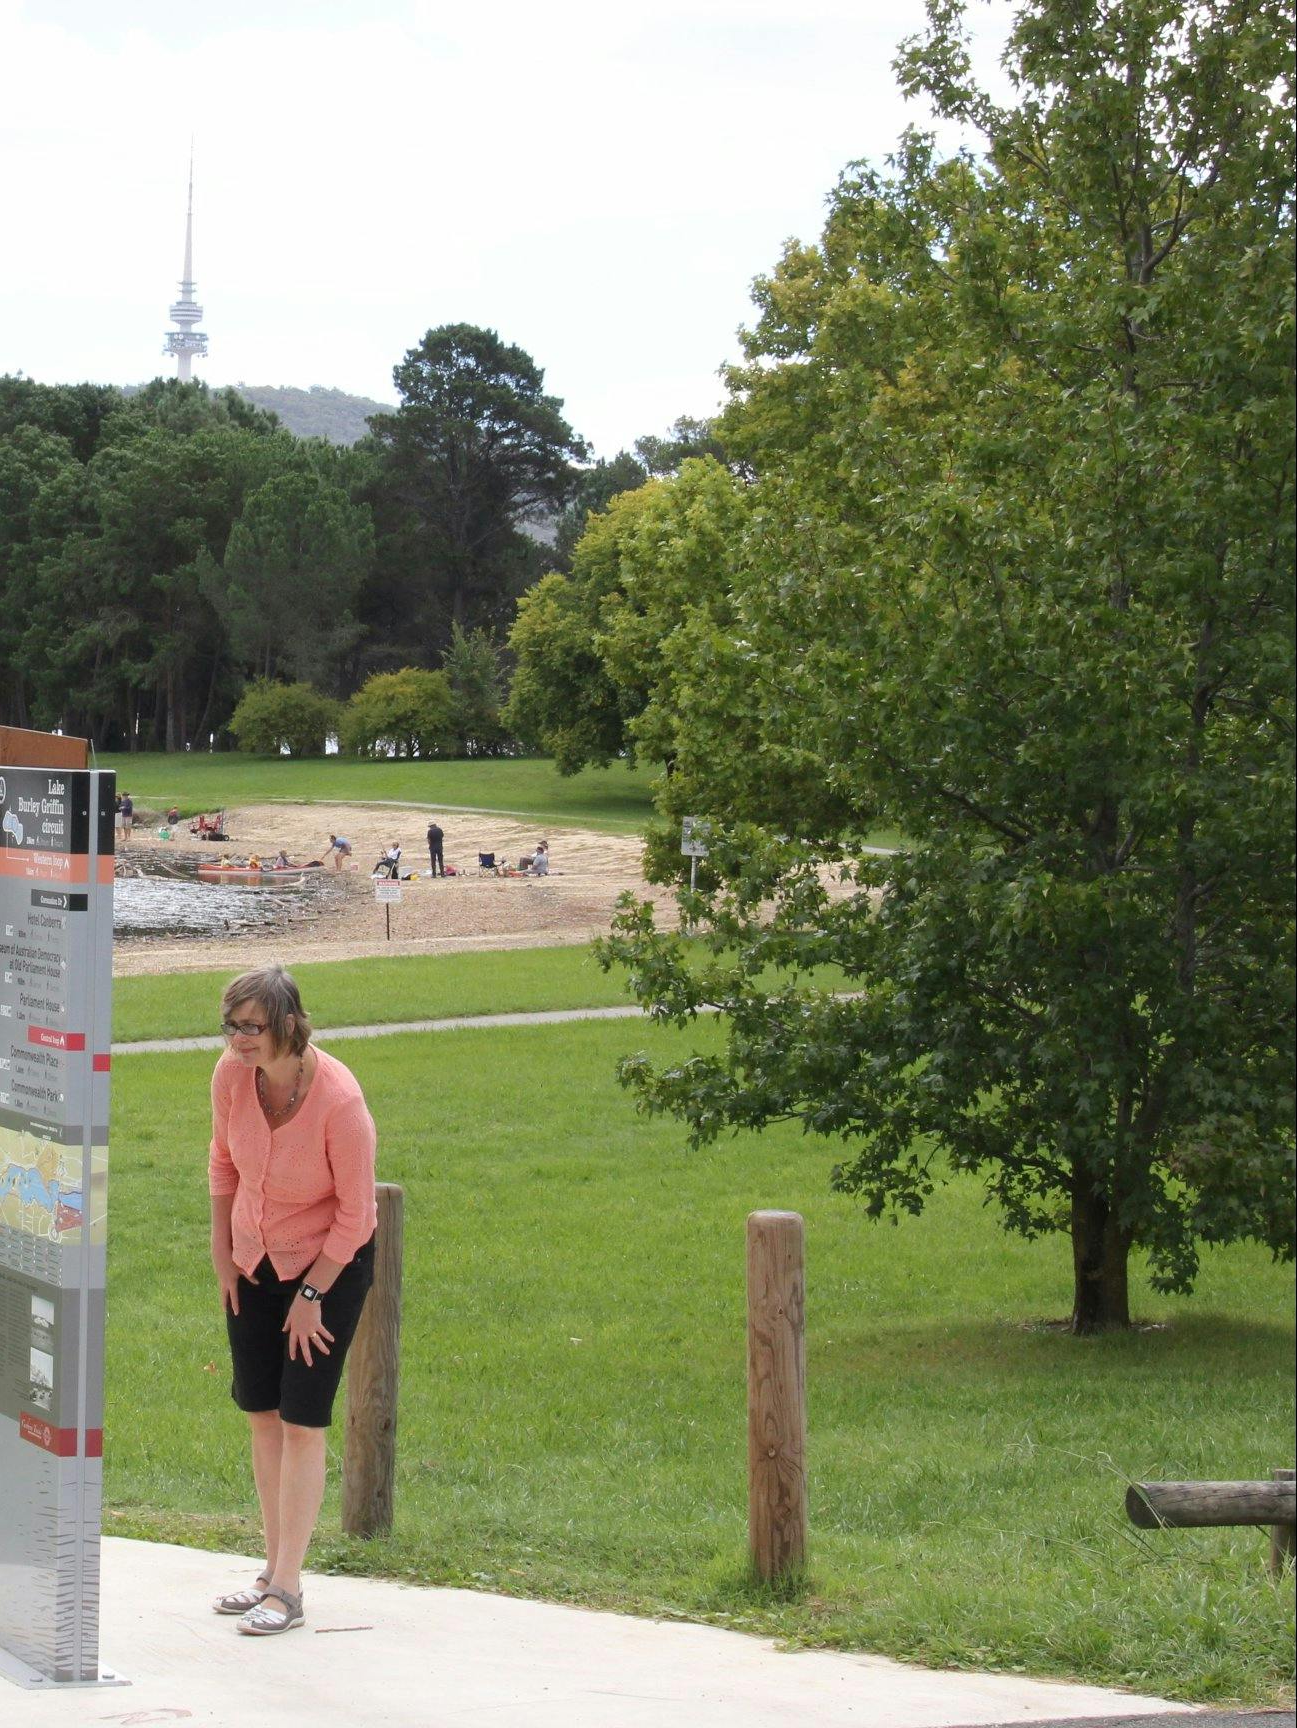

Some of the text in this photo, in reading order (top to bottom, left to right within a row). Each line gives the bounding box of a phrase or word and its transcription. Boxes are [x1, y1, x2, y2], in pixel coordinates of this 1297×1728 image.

[48, 779, 65, 795] Lake
[18, 797, 64, 818] Burley Griffin
[42, 818, 64, 835] circuit
[27, 911, 40, 926] Hotel
[47, 966, 61, 978] House
[19, 992, 60, 1013] Parliament House
[10, 1044, 46, 1065] Commonwealth
[11, 1079, 46, 1100] Commonwealth
